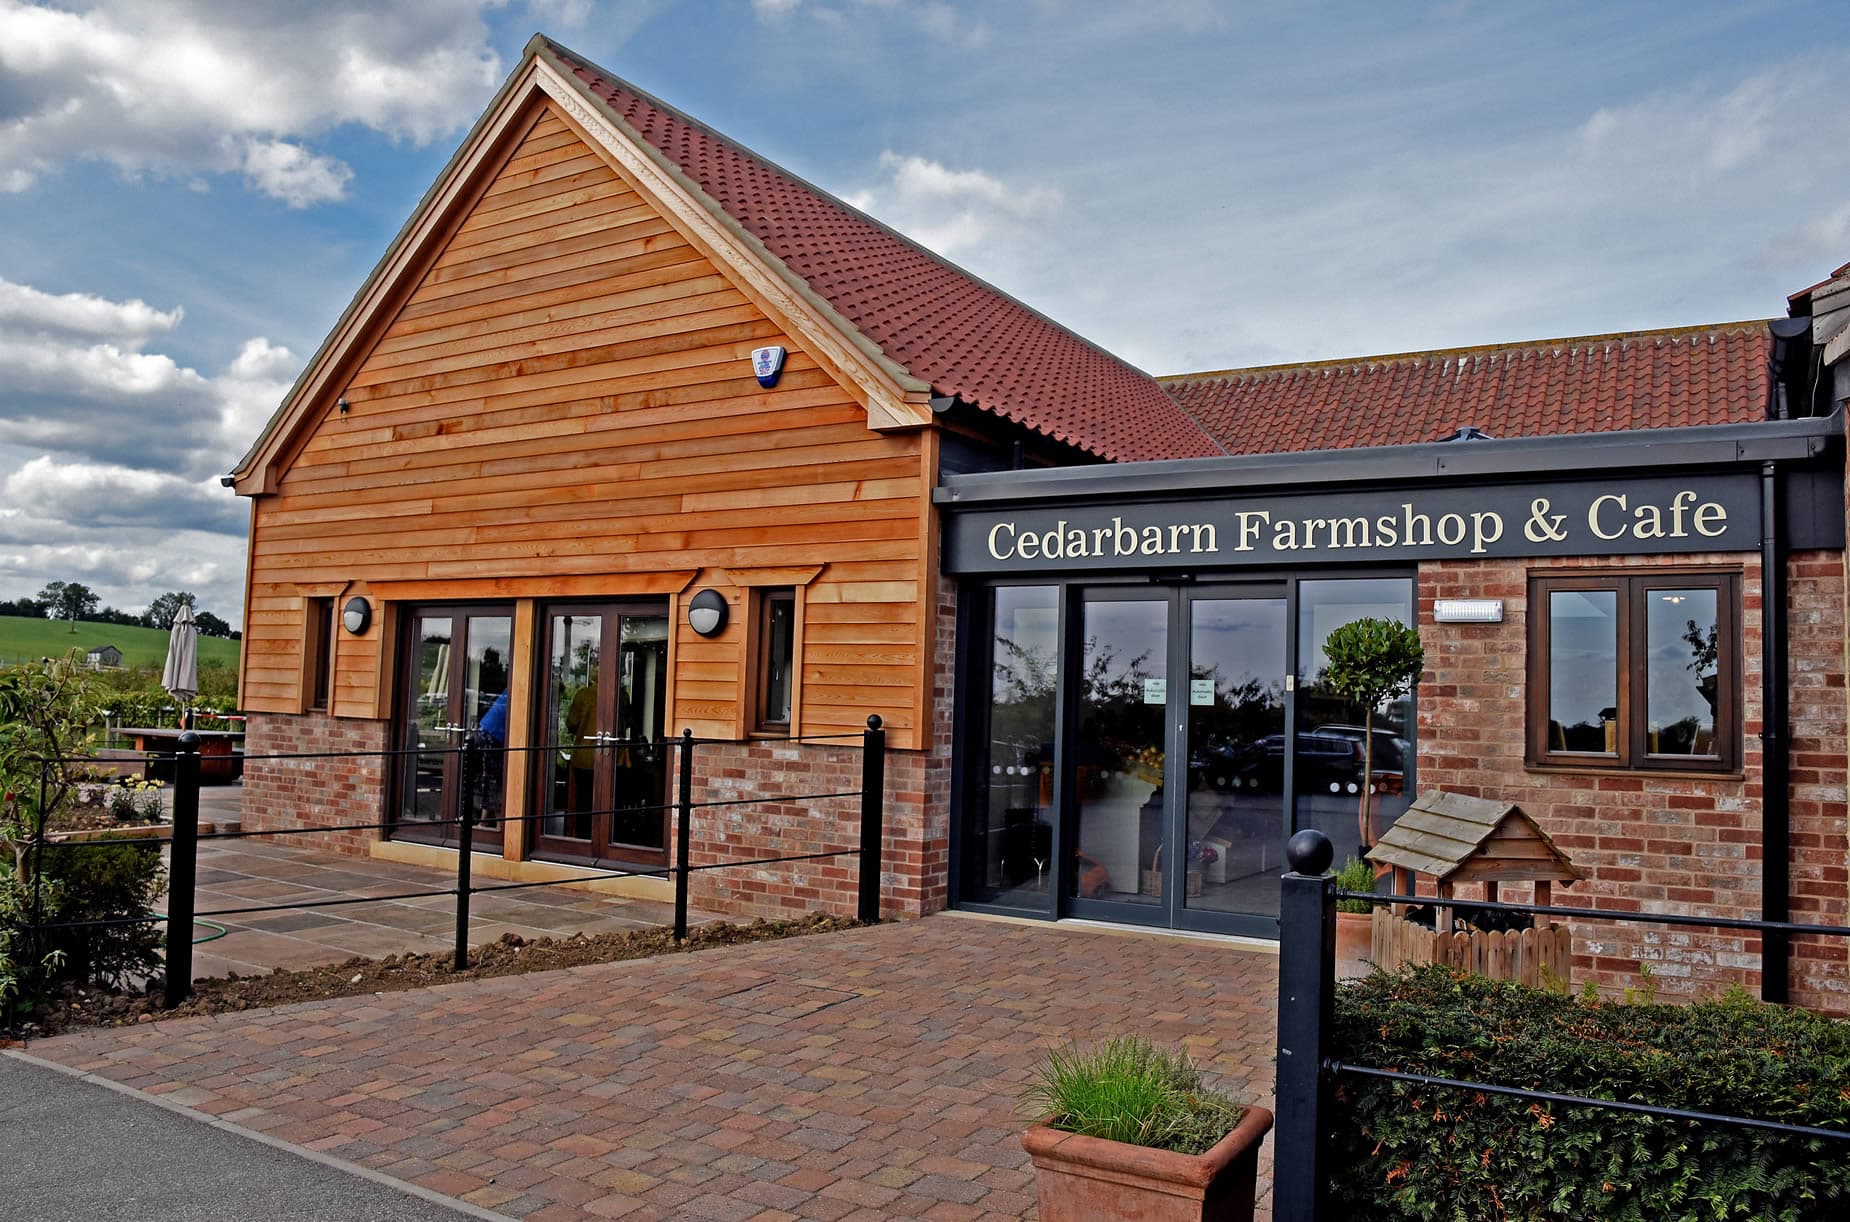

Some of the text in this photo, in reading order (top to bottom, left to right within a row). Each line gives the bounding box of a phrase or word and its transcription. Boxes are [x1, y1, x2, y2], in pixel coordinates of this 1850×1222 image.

[987, 491, 1728, 560] Cedarbarn Farmshop & Cafe
